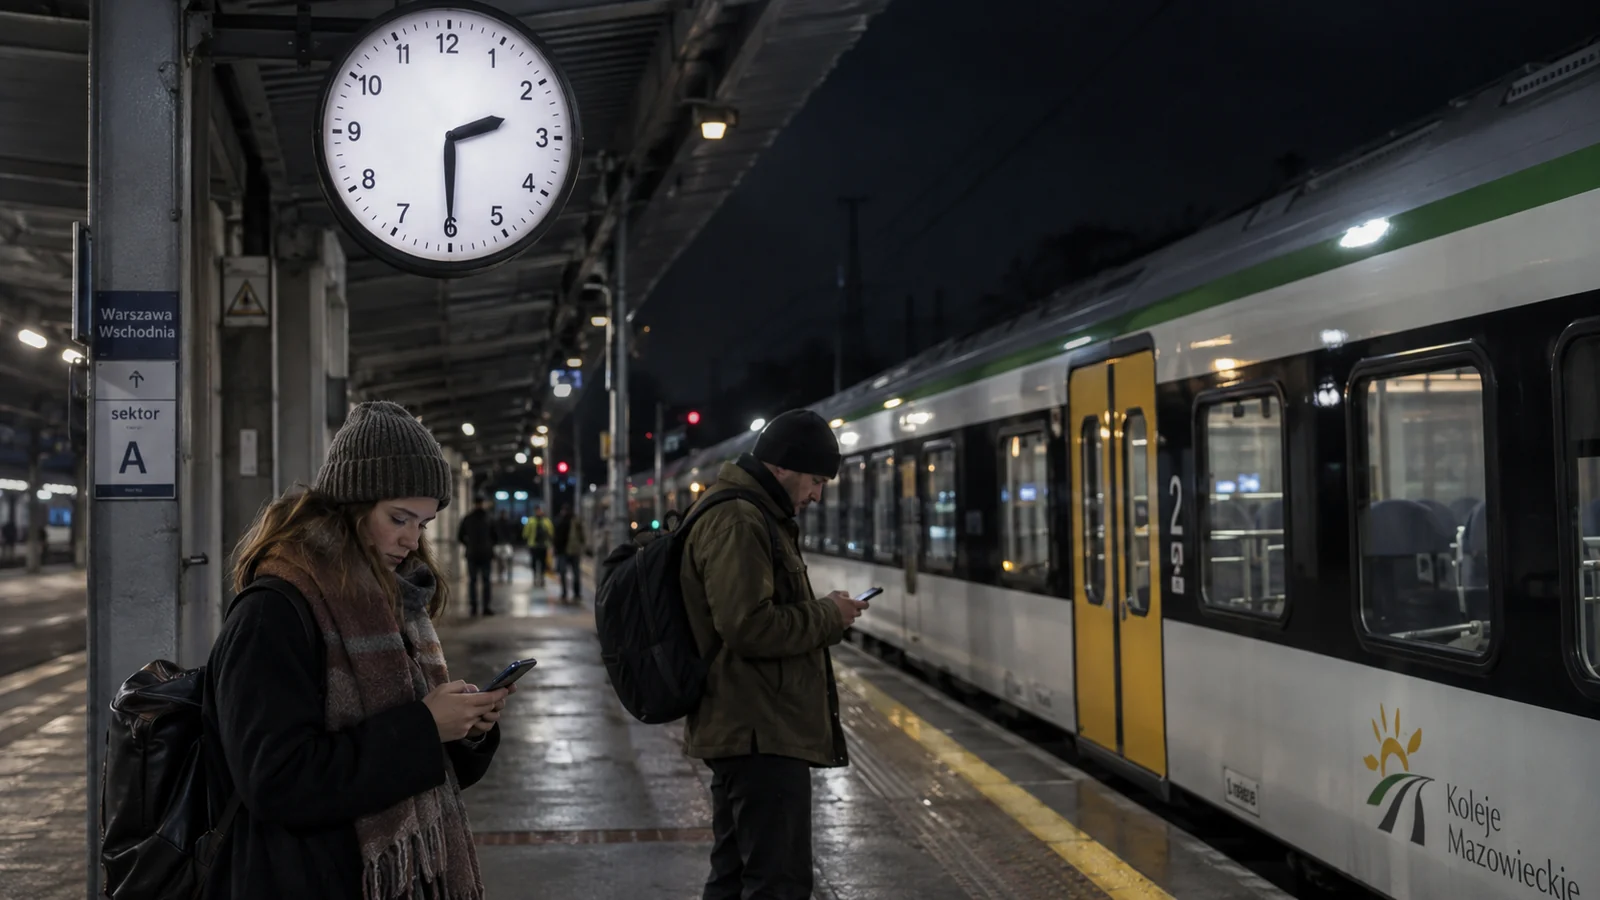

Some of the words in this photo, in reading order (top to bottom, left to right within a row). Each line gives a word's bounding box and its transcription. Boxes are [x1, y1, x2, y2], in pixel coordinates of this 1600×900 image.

[395, 43, 410, 64] 11
[436, 33, 459, 54] 12
[487, 48, 496, 69] 1
[358, 75, 382, 95] 10
[520, 80, 533, 101] 2
[347, 121, 361, 142] 9
[535, 128, 549, 148] 3
[362, 168, 376, 189] 8
[522, 173, 536, 193] 4
[396, 203, 410, 224] 7
[490, 206, 503, 226] 5
[443, 216, 458, 238] 6
[102, 308, 172, 321] Warszawa
[100, 325, 176, 339] Wschodnia
[111, 406, 160, 420] sektor
[118, 441, 147, 474] A
[1169, 475, 1184, 535] 2
[1447, 783, 1501, 837] Koleje
[1448, 824, 1580, 900] Mazowieckie
